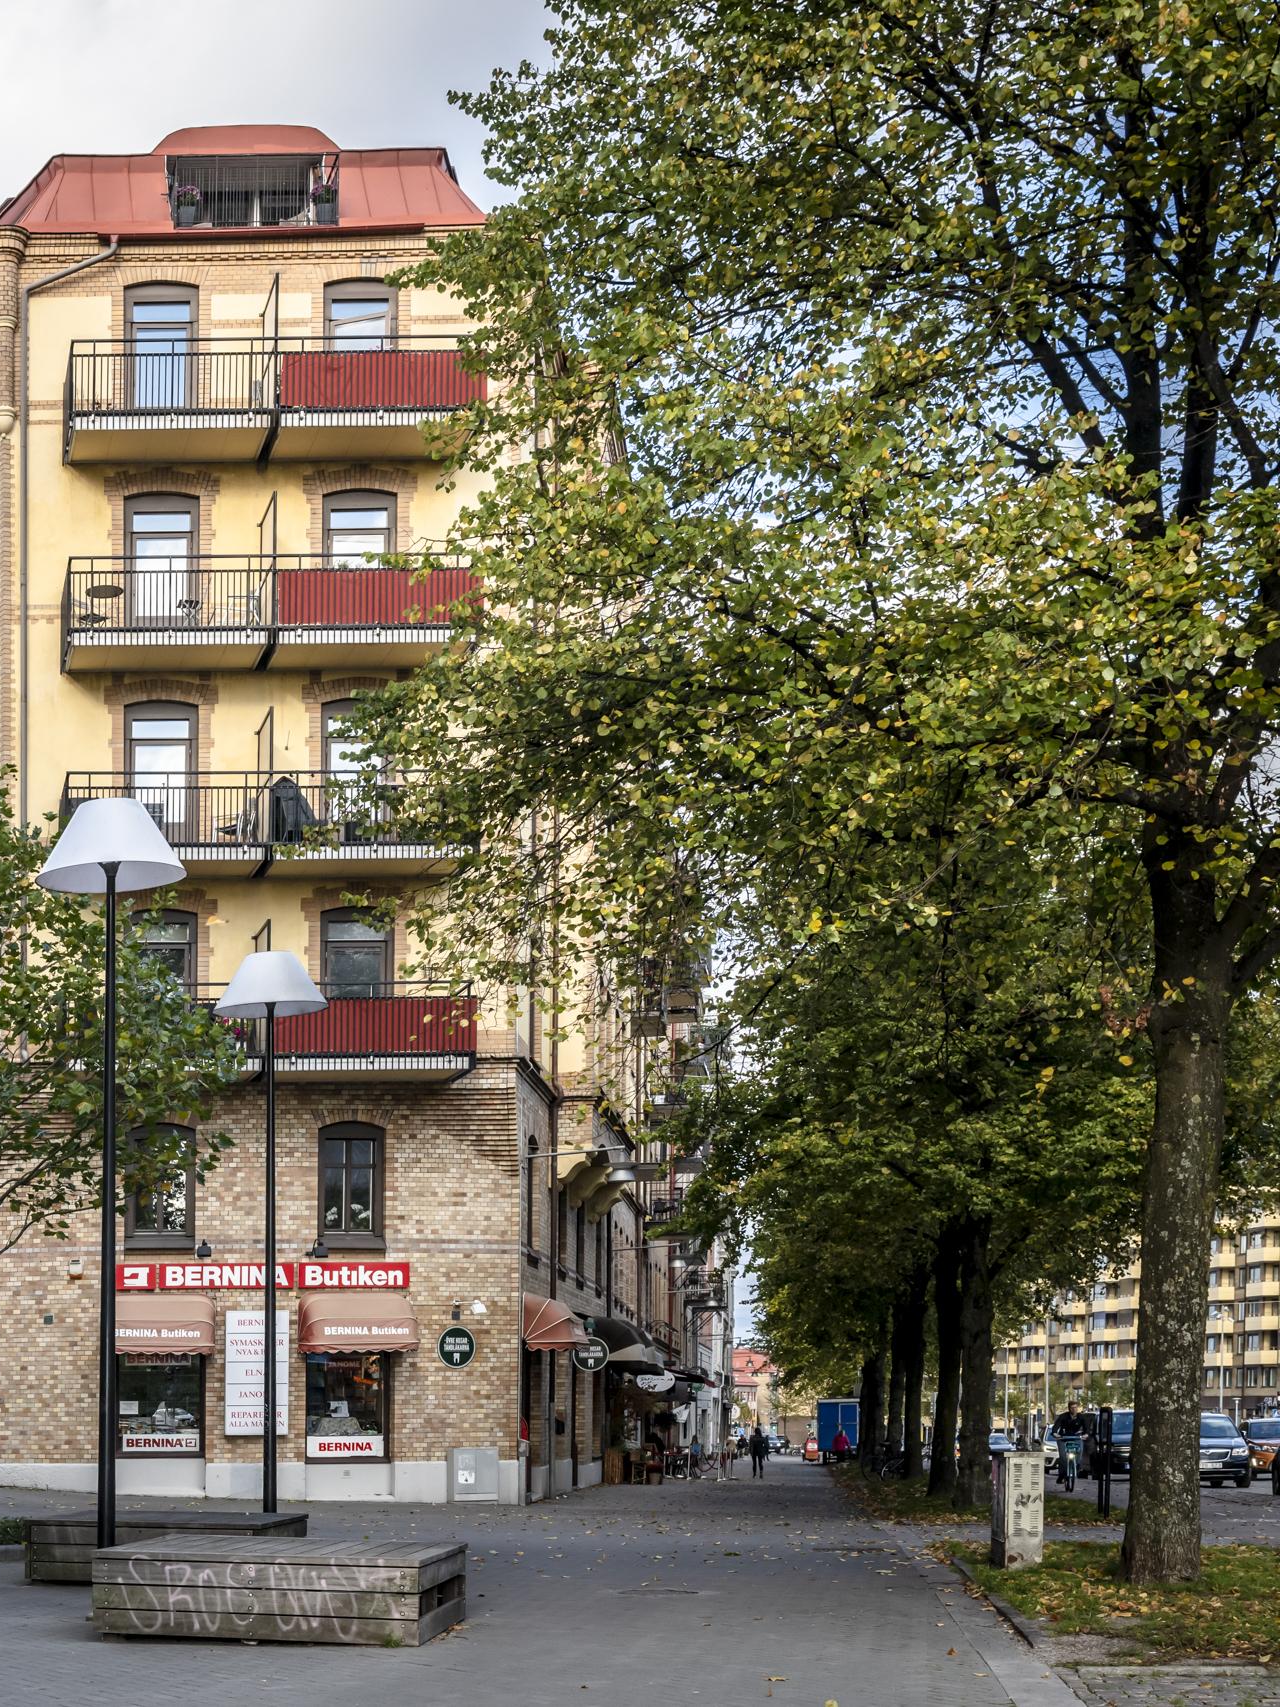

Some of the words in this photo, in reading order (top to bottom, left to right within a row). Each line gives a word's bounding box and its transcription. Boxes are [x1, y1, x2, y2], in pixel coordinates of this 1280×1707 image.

[164, 1266, 288, 1287] BERNINA
[304, 1265, 404, 1286] Butiken
[161, 1328, 200, 1338] Butiken
[324, 1326, 369, 1336] BERNINA
[371, 1326, 410, 1335] Butiken
[229, 1338, 285, 1347] SYMASKR
[235, 1348, 252, 1356] NYA
[253, 1348, 260, 1356] &
[231, 1411, 283, 1419] REPARER
[229, 1420, 249, 1428] ALLA
[250, 1418, 286, 1428] MÄN
[125, 1438, 184, 1449] BERNINA
[318, 1442, 373, 1452] BERNINA
